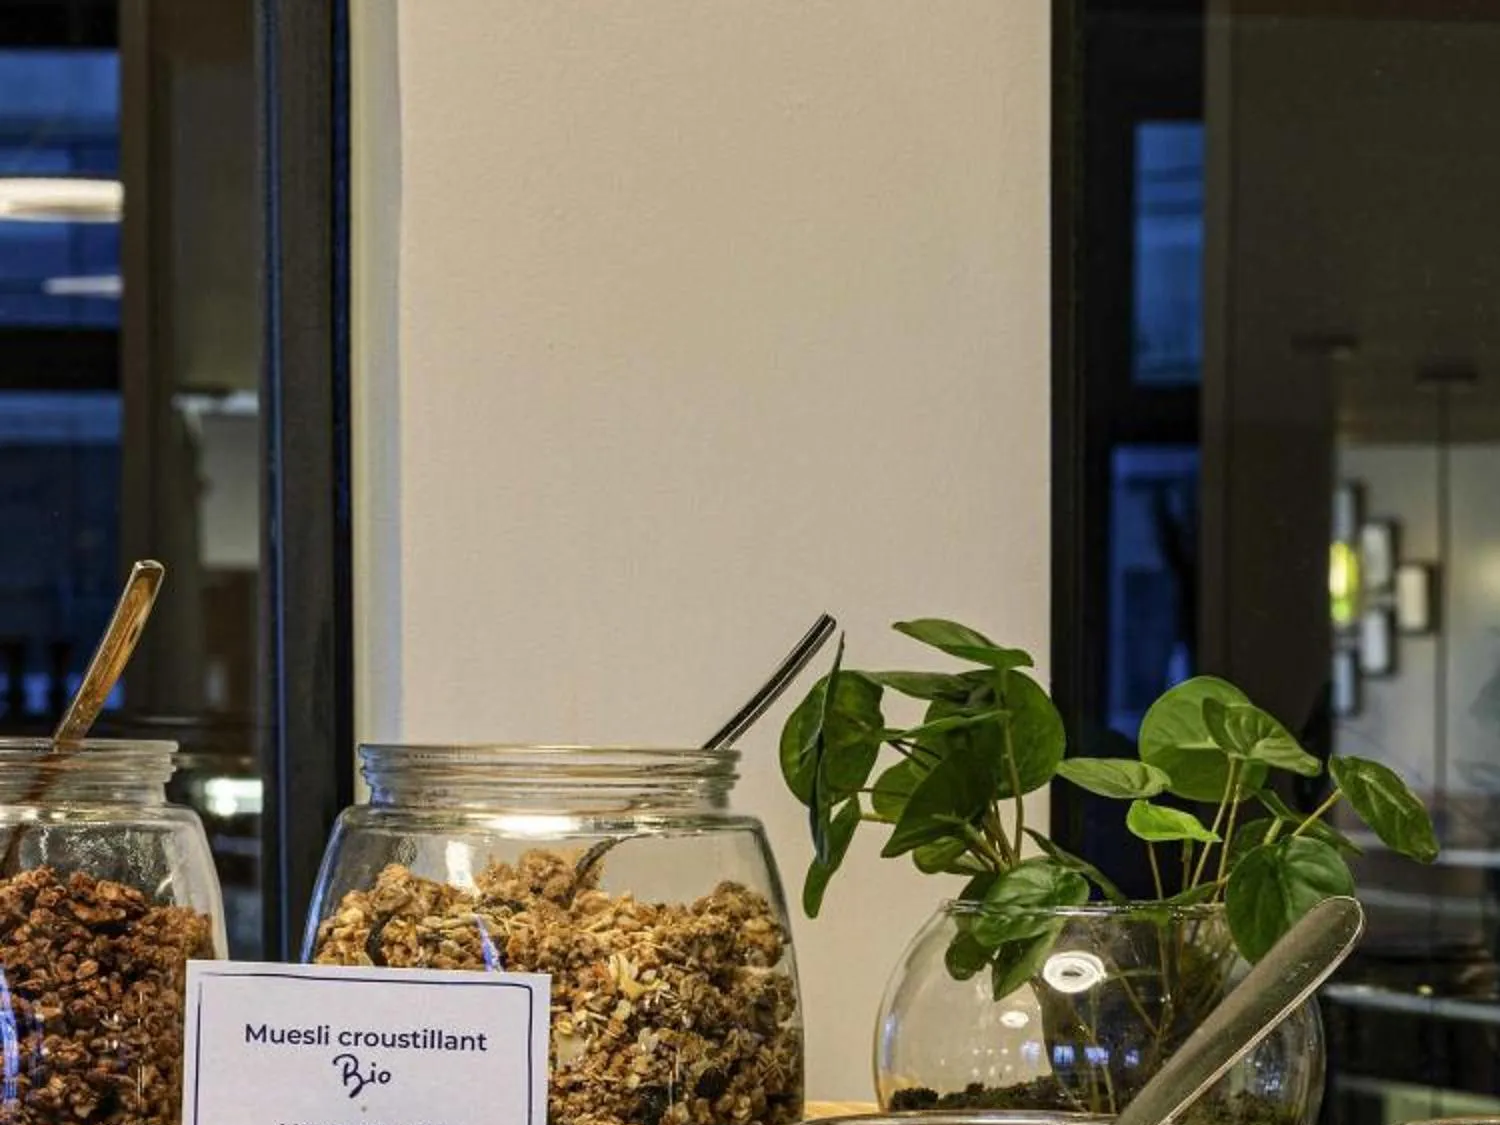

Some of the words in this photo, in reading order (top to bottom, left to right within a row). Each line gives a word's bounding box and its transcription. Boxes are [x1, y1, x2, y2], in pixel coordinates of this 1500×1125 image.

[245, 1024, 330, 1046] Muesli
[337, 1027, 488, 1052] croustillant
[332, 1053, 391, 1099] Bio
